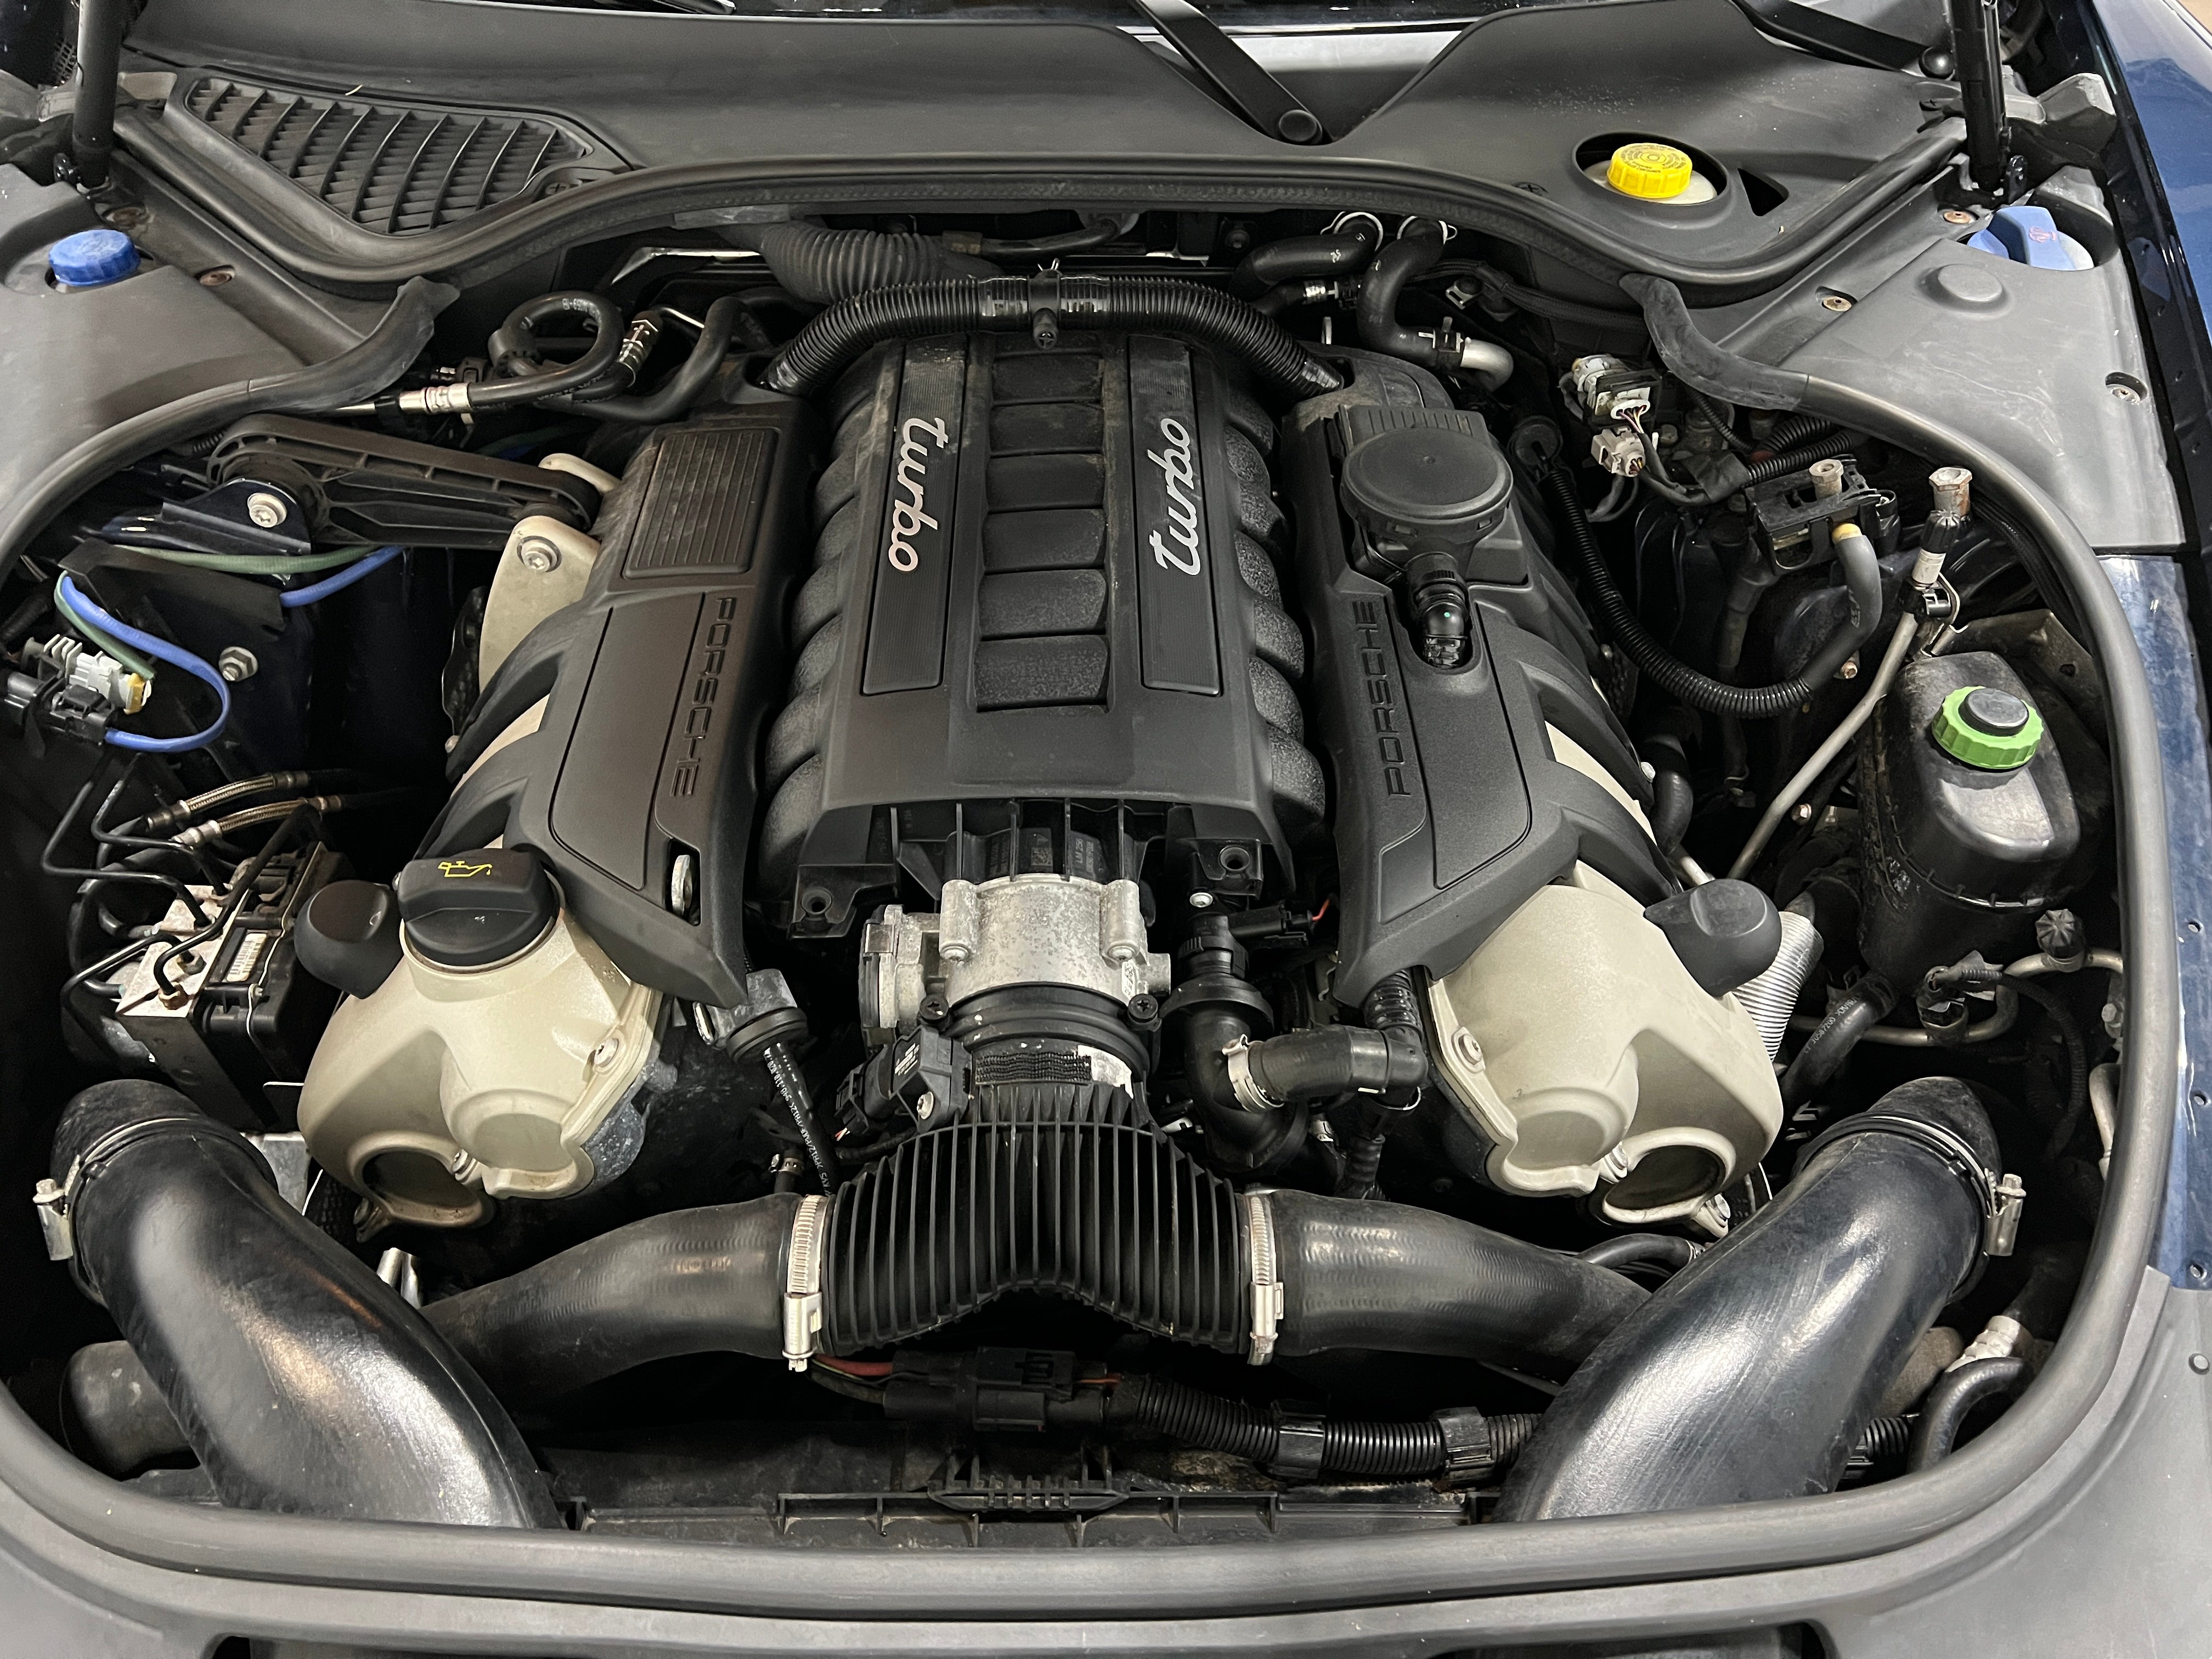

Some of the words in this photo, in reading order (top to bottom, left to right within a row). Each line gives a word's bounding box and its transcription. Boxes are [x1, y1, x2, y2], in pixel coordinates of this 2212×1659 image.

[888, 417, 949, 572] turbo
[1147, 417, 1200, 575] turbo
[670, 596, 737, 797] PORSCHE
[1352, 601, 1412, 797] PORSCHE
